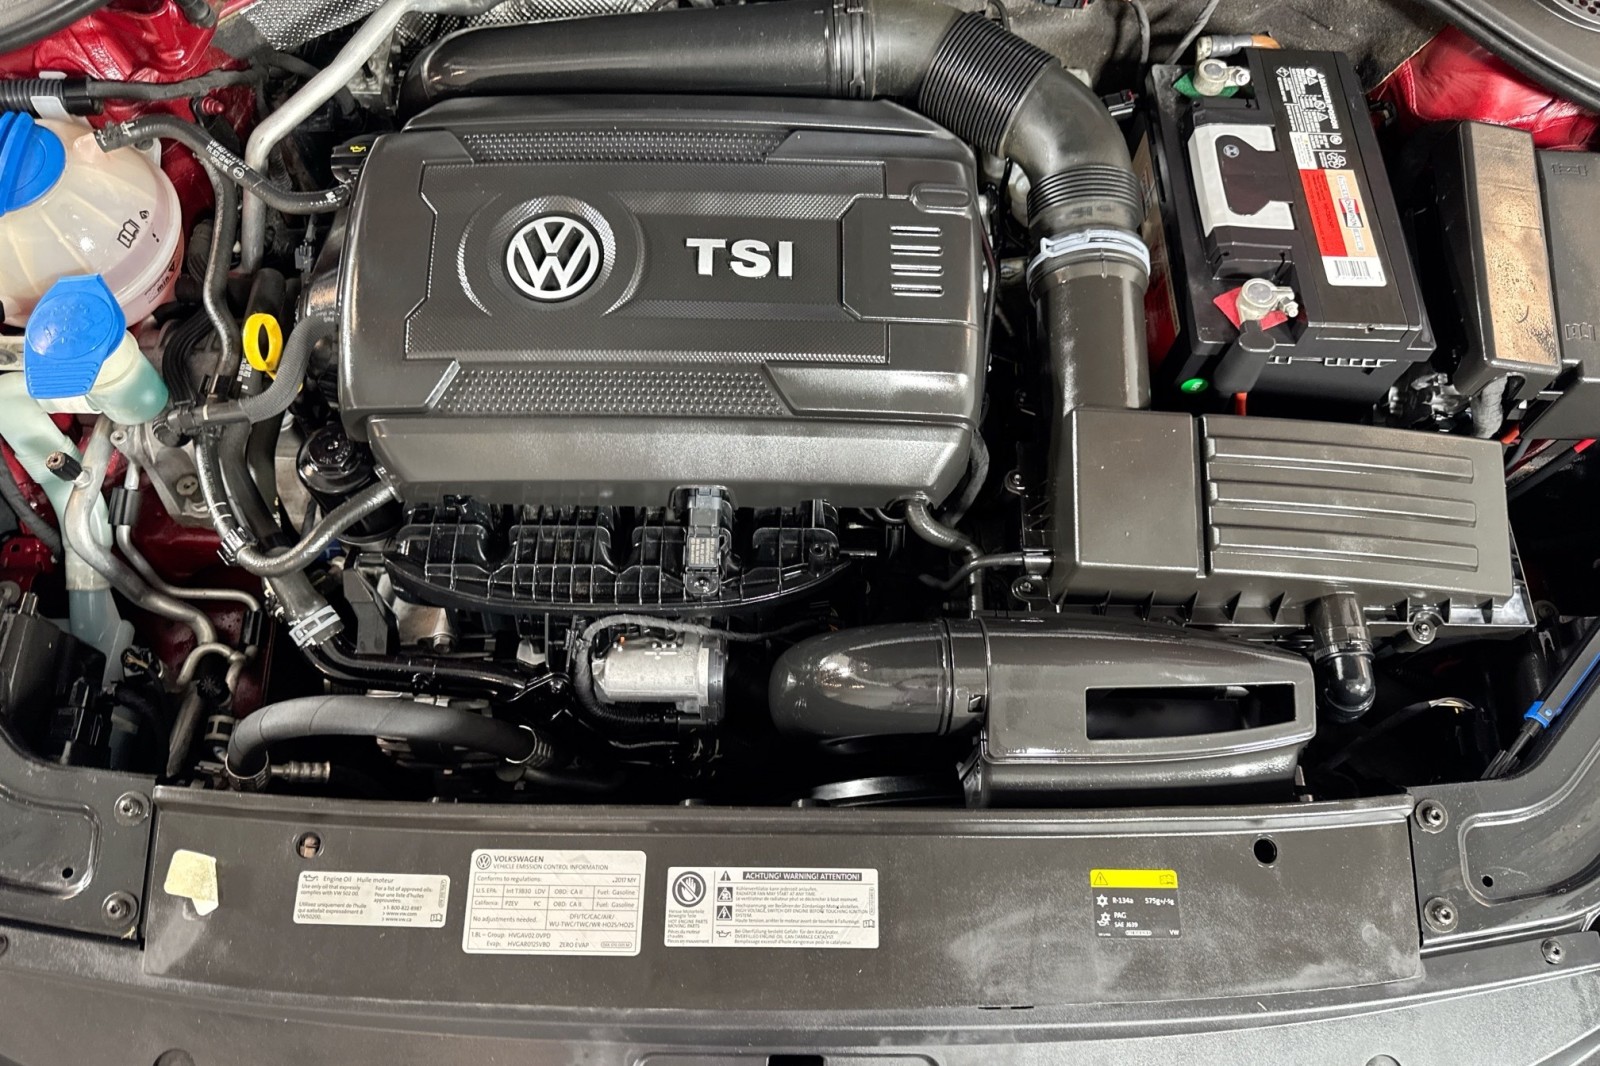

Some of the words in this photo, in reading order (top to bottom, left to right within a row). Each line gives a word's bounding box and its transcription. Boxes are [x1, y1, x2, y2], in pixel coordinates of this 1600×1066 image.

[506, 216, 600, 299] VW
[686, 238, 793, 280] TSI
[157, 276, 170, 292] min
